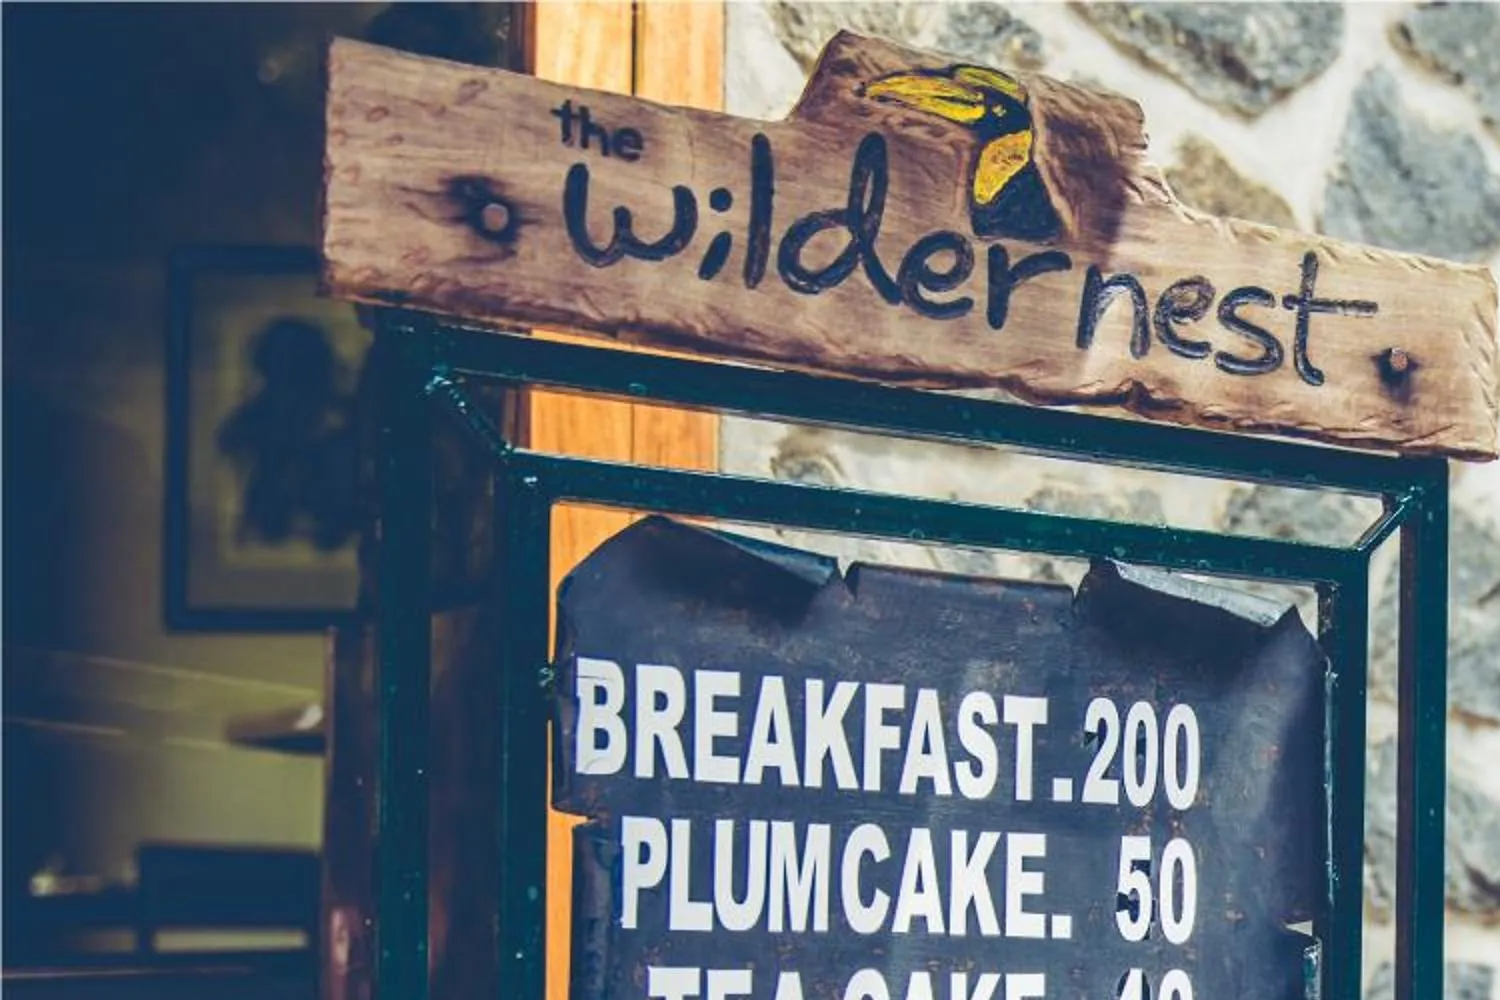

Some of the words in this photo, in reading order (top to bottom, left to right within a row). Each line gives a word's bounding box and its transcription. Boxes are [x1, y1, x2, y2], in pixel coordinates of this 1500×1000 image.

[551, 101, 644, 161] the
[1083, 697, 1201, 811] 200
[1116, 834, 1197, 945] 50
